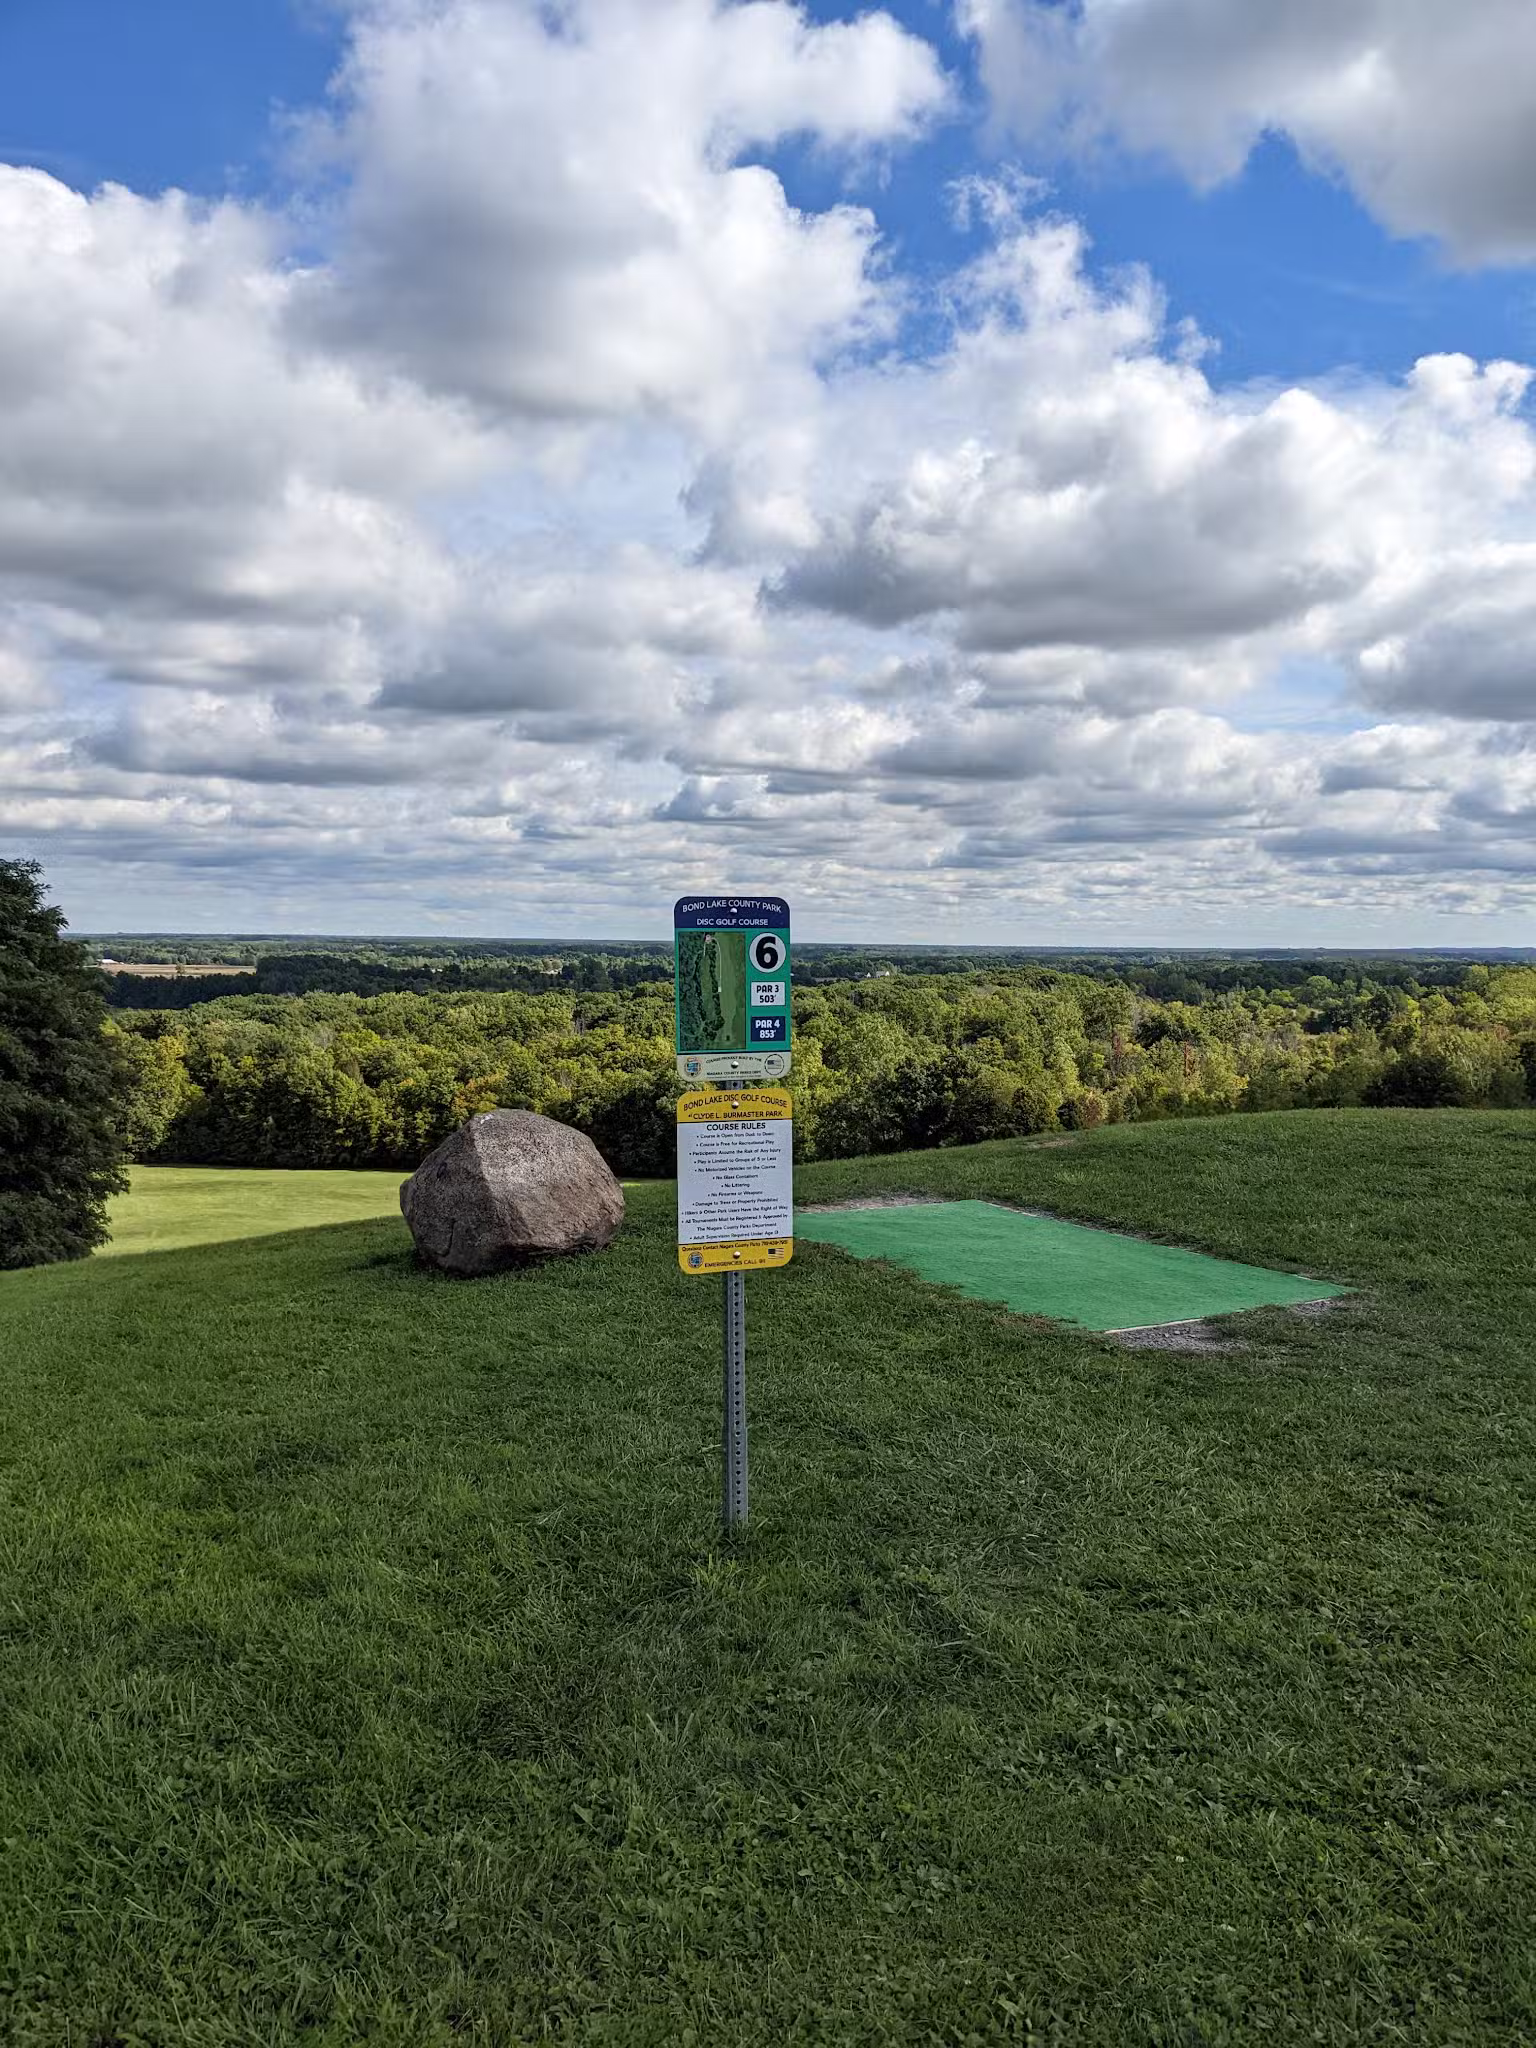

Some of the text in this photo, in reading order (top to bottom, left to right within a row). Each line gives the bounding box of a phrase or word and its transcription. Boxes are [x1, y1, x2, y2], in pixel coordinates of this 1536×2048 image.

[682, 900, 782, 913] BOND LAKE COUNTY PARK
[756, 936, 778, 969] 6
[756, 985, 772, 993] PAR
[755, 1020, 780, 1028] PAR 4
[684, 1100, 704, 1111] BOND
[705, 1096, 722, 1104] LAKE
[760, 1096, 788, 1108] COURSE
